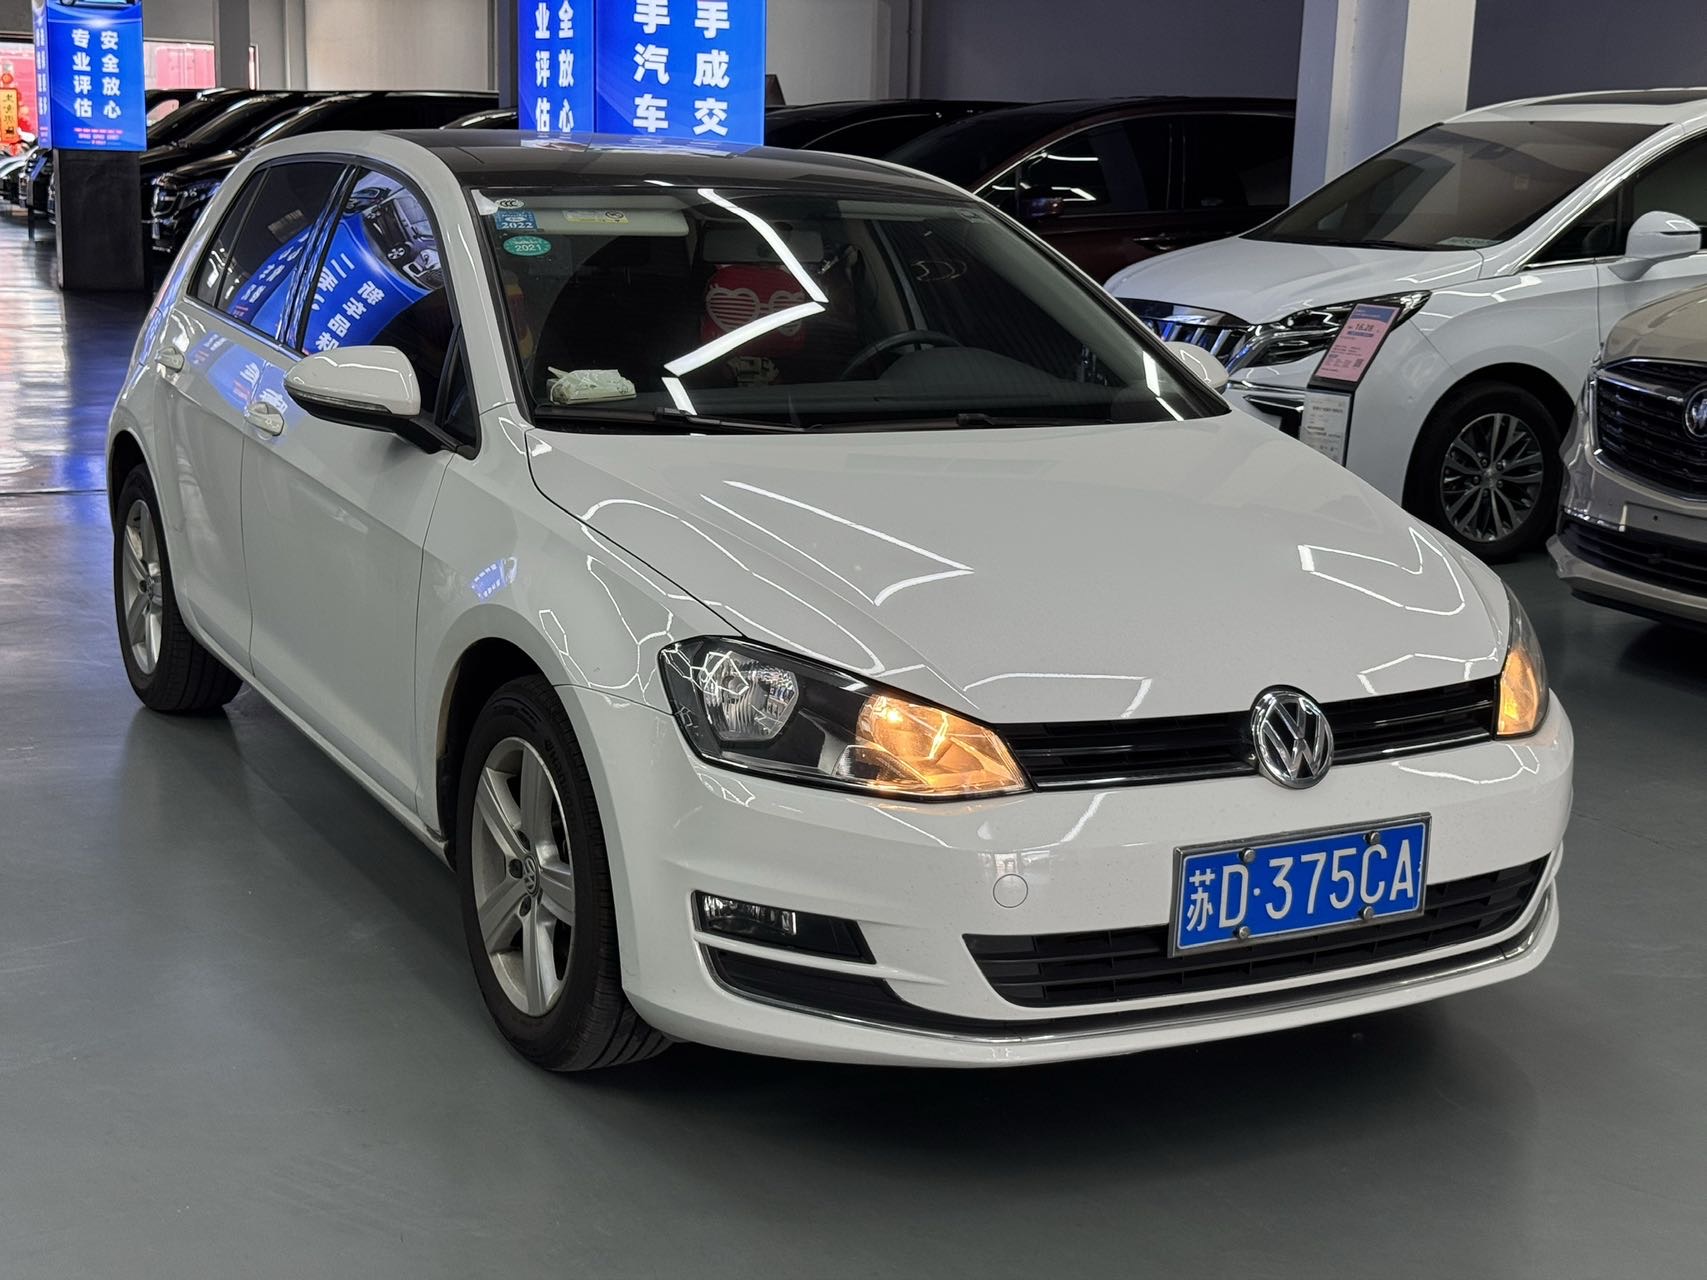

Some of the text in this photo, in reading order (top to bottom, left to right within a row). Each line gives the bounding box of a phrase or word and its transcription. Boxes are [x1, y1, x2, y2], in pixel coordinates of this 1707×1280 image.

[72, 28, 93, 118] 专业评估
[101, 30, 121, 119] 安全放心
[535, 2, 550, 133] 业评估
[558, 0, 574, 133] 全放心
[514, 244, 541, 252] 2021
